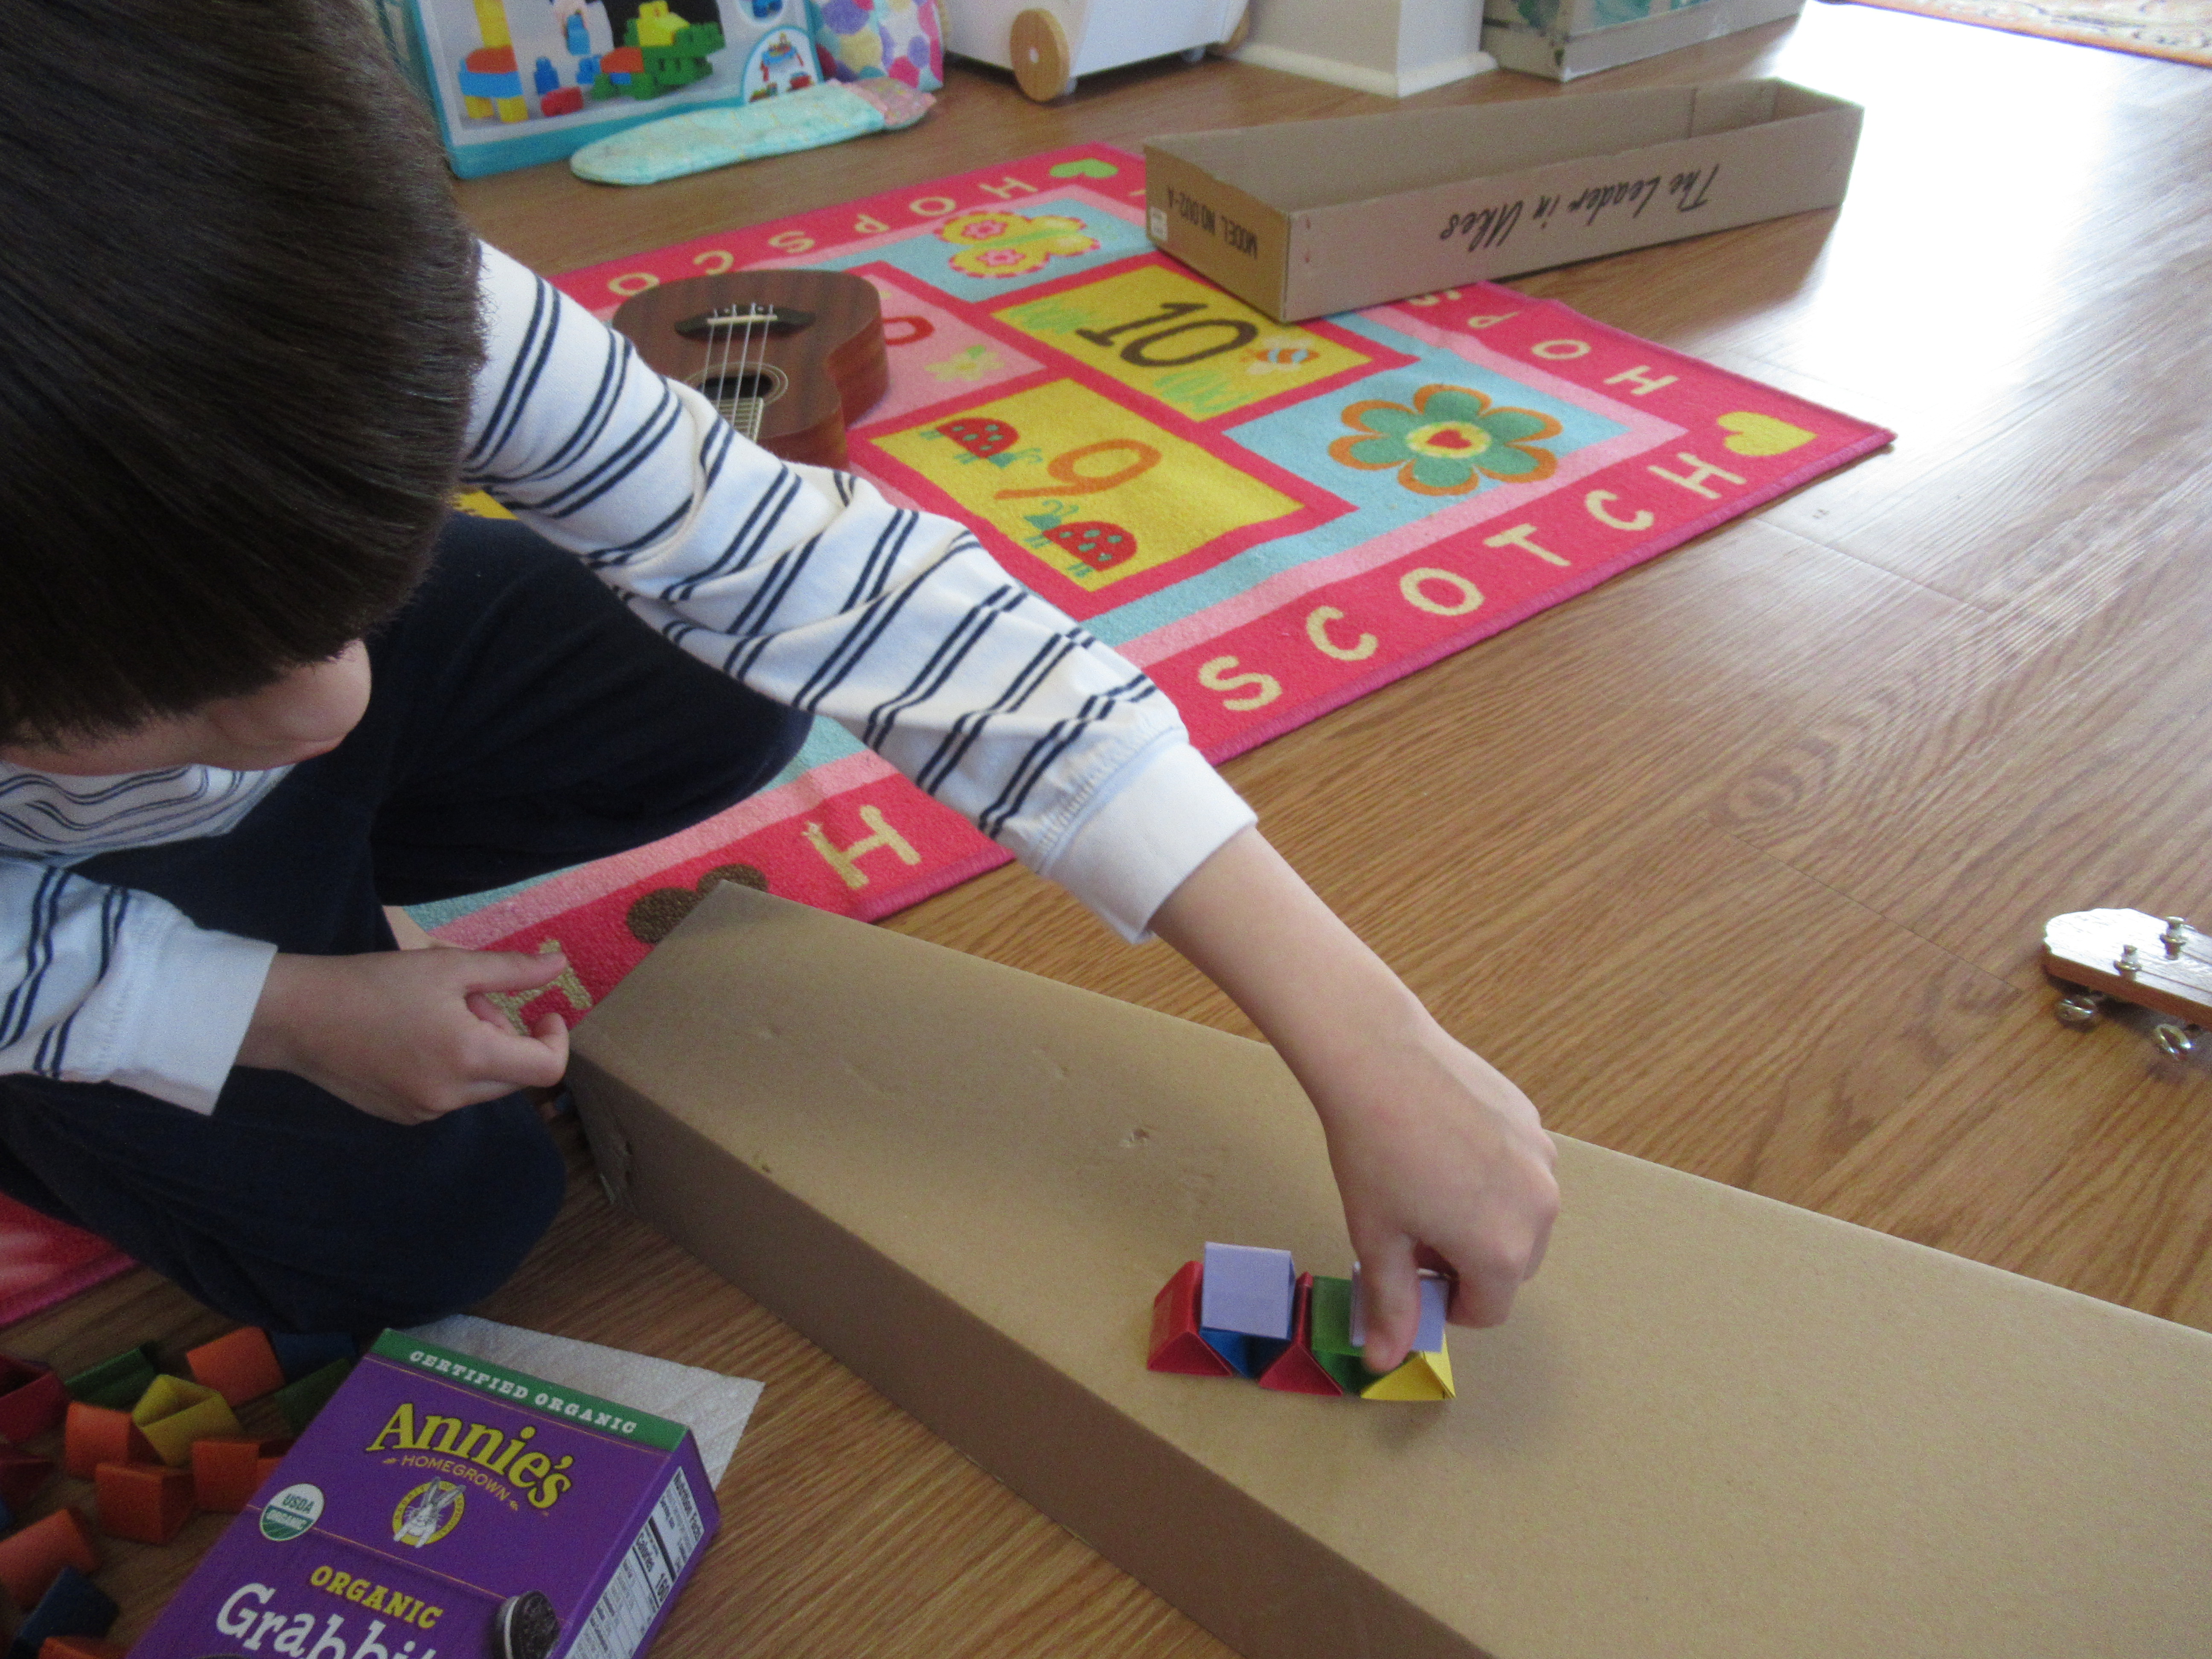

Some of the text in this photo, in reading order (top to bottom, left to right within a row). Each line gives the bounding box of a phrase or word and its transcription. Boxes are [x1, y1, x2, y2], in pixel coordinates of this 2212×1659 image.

[1440, 163, 1720, 253] The Leader in Ukes
[1075, 303, 1259, 367] 10
[409, 1350, 638, 1435] CERTIFIED ORGANIC
[365, 1403, 574, 1509] Annie's
[401, 1454, 512, 1502] HOMEGROWN
[282, 1493, 314, 1515] USDA
[311, 1566, 444, 1629] ORGANIC
